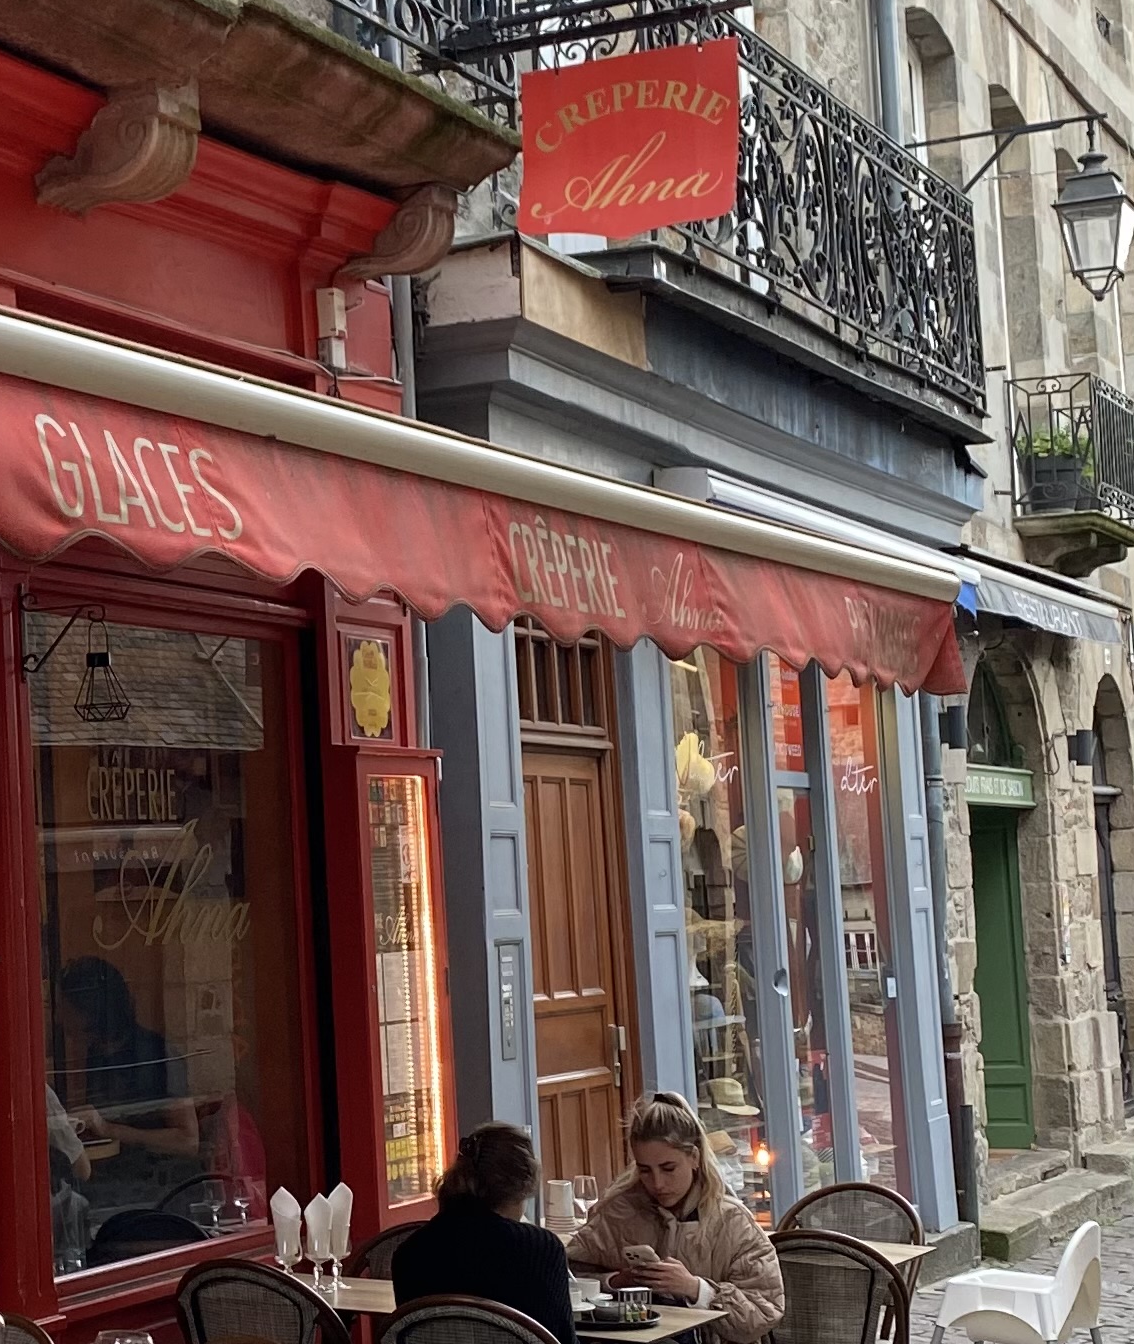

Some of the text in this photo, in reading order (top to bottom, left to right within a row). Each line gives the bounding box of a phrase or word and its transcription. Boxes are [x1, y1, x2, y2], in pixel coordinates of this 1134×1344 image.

[535, 79, 731, 153] CREPERIE
[34, 413, 244, 541] GLACES
[509, 514, 626, 619] CRÊPERIE
